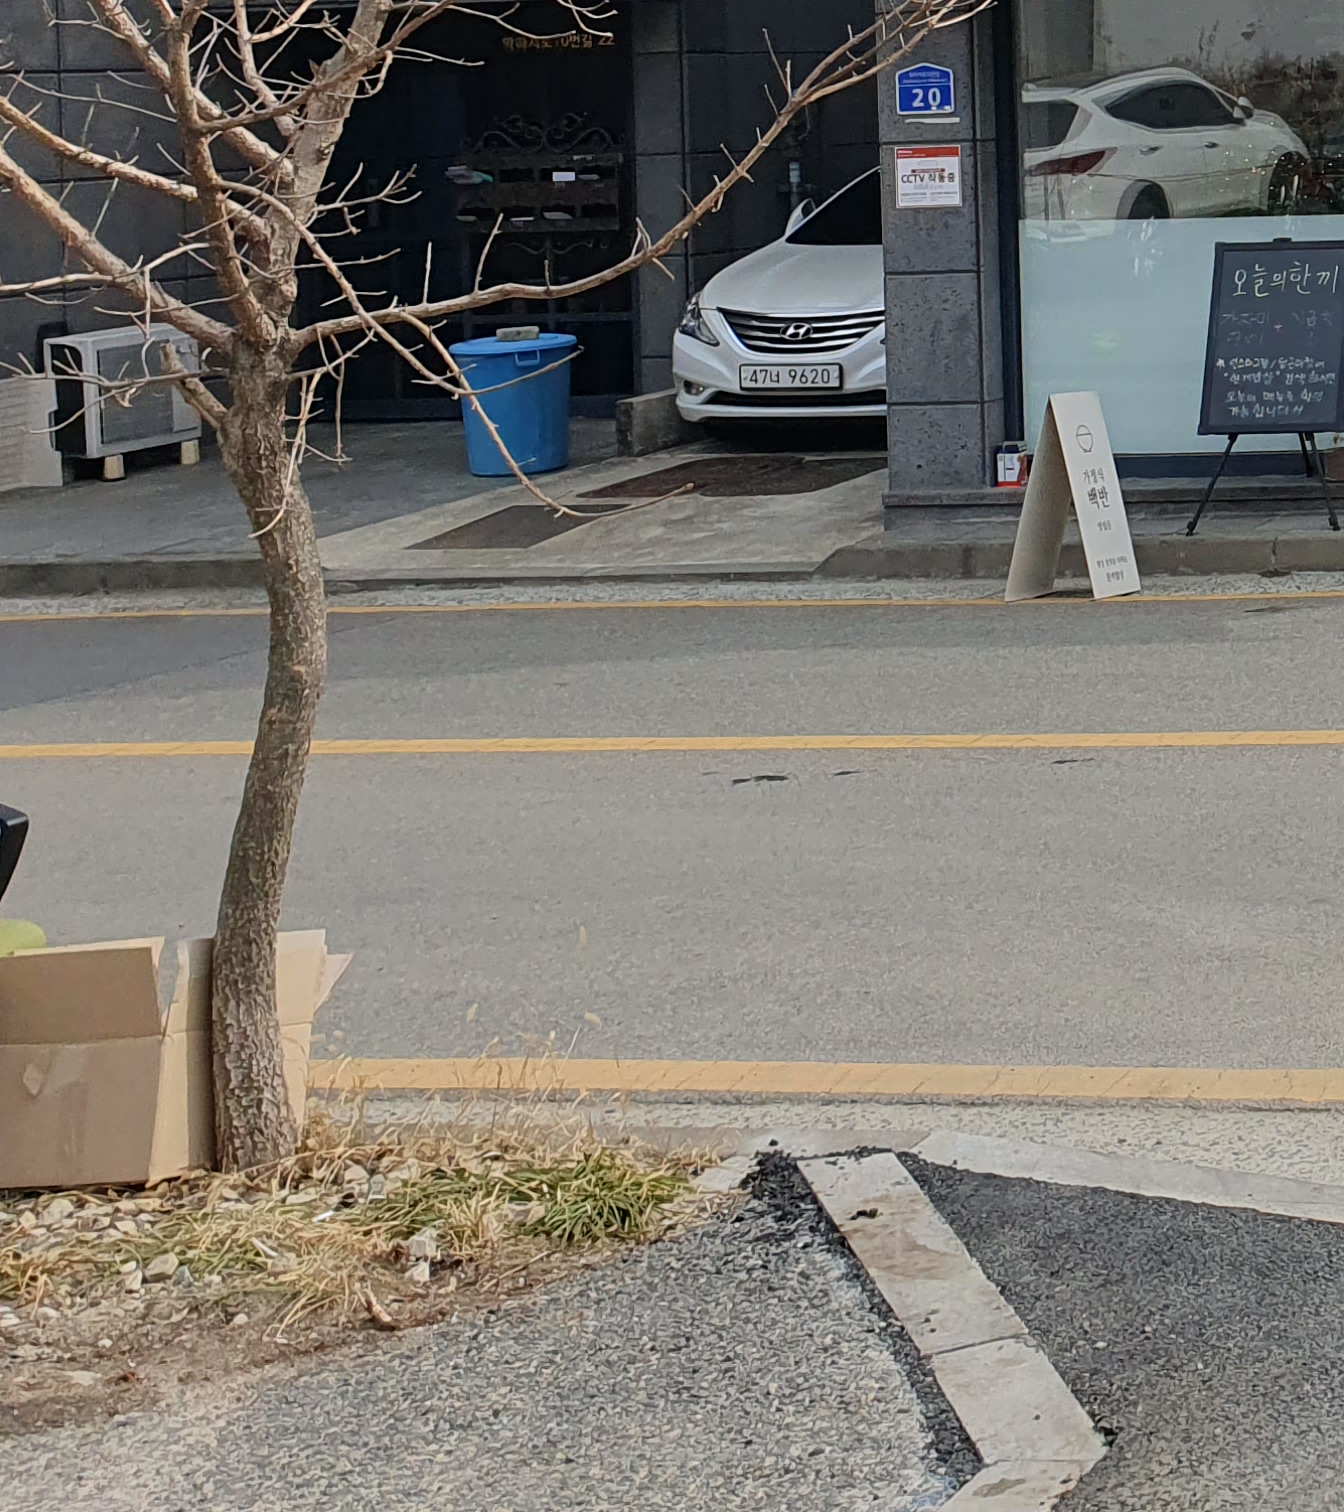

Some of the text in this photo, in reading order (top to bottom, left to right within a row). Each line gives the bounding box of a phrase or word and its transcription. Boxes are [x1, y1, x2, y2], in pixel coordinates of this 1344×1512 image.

[911, 87, 941, 108] 20
[901, 173, 925, 184] CCTV
[749, 368, 830, 385] 47너 9620
[1087, 487, 1111, 510] 백반
